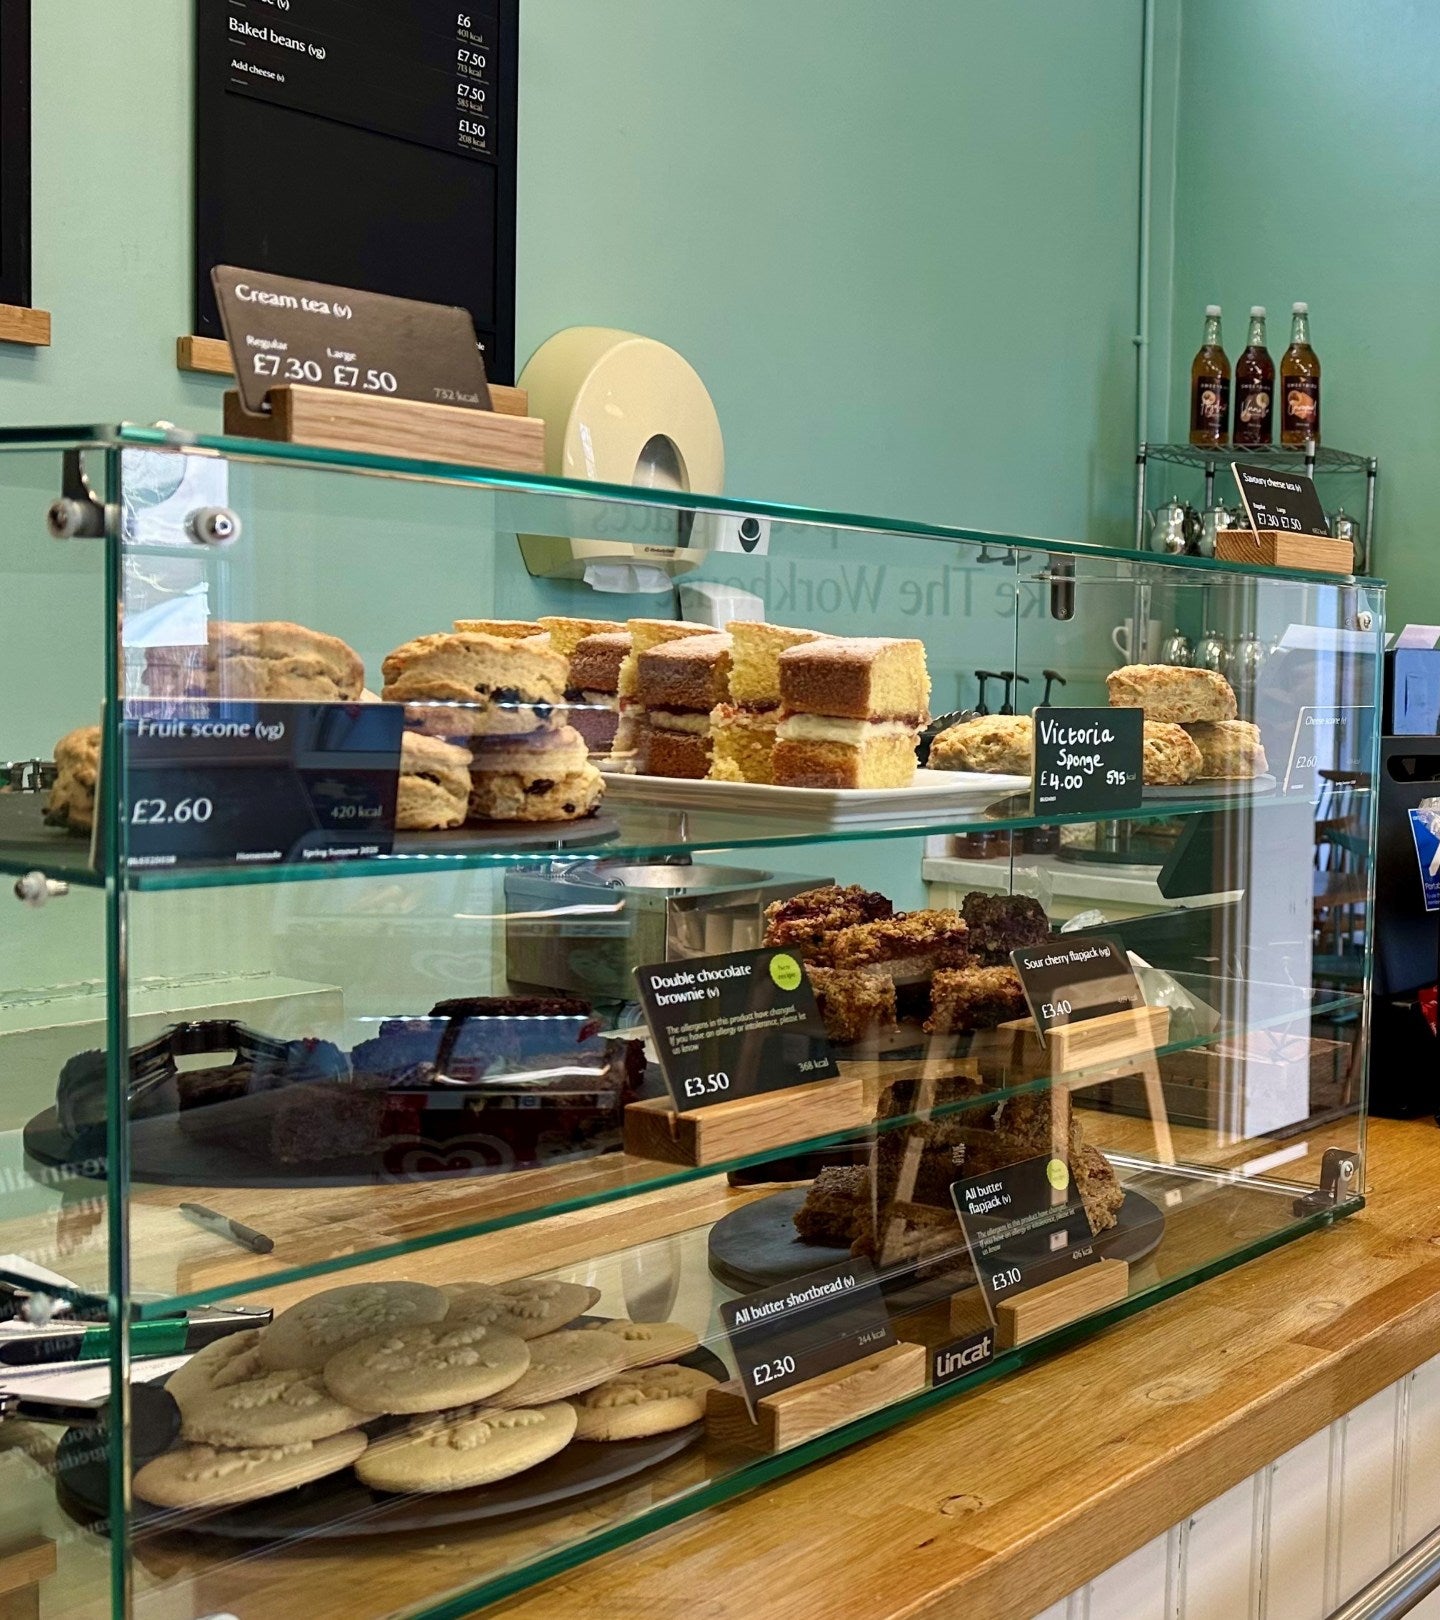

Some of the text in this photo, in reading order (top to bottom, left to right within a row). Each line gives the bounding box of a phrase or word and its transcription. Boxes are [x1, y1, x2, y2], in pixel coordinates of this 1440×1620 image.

[457, 14, 471, 28] £6
[229, 17, 326, 59] Baked beans (vg)
[231, 60, 276, 79] Add cheese
[457, 49, 485, 68] £7.50
[457, 84, 485, 102] £7.50
[459, 120, 485, 137] £1.50
[235, 284, 352, 319] Cream tea (v)
[246, 335, 357, 361] Regular Large
[253, 353, 397, 391] £7.30 £7.50
[137, 719, 284, 740] Fruit scone (vg)
[1041, 719, 1114, 745] Victoria
[1057, 748, 1104, 774] Sponge
[1041, 771, 1083, 790] £4.00
[131, 798, 382, 824] £2.60 420 kcal
[1024, 946, 1110, 970] Sour cherry flapjack (vg)
[651, 964, 752, 990] Double chocolate
[655, 987, 720, 1006] brownie (v)
[1042, 1000, 1072, 1018] £3.40
[684, 1058, 829, 1097] £3.50 368 kcal
[965, 1182, 1003, 1201] All butter
[968, 1195, 1012, 1215] flapjack (v)
[992, 1267, 1021, 1291] £3.10
[735, 1274, 856, 1326] All butter shortbread (v)
[753, 1328, 886, 1386] £2.30 244 kcal
